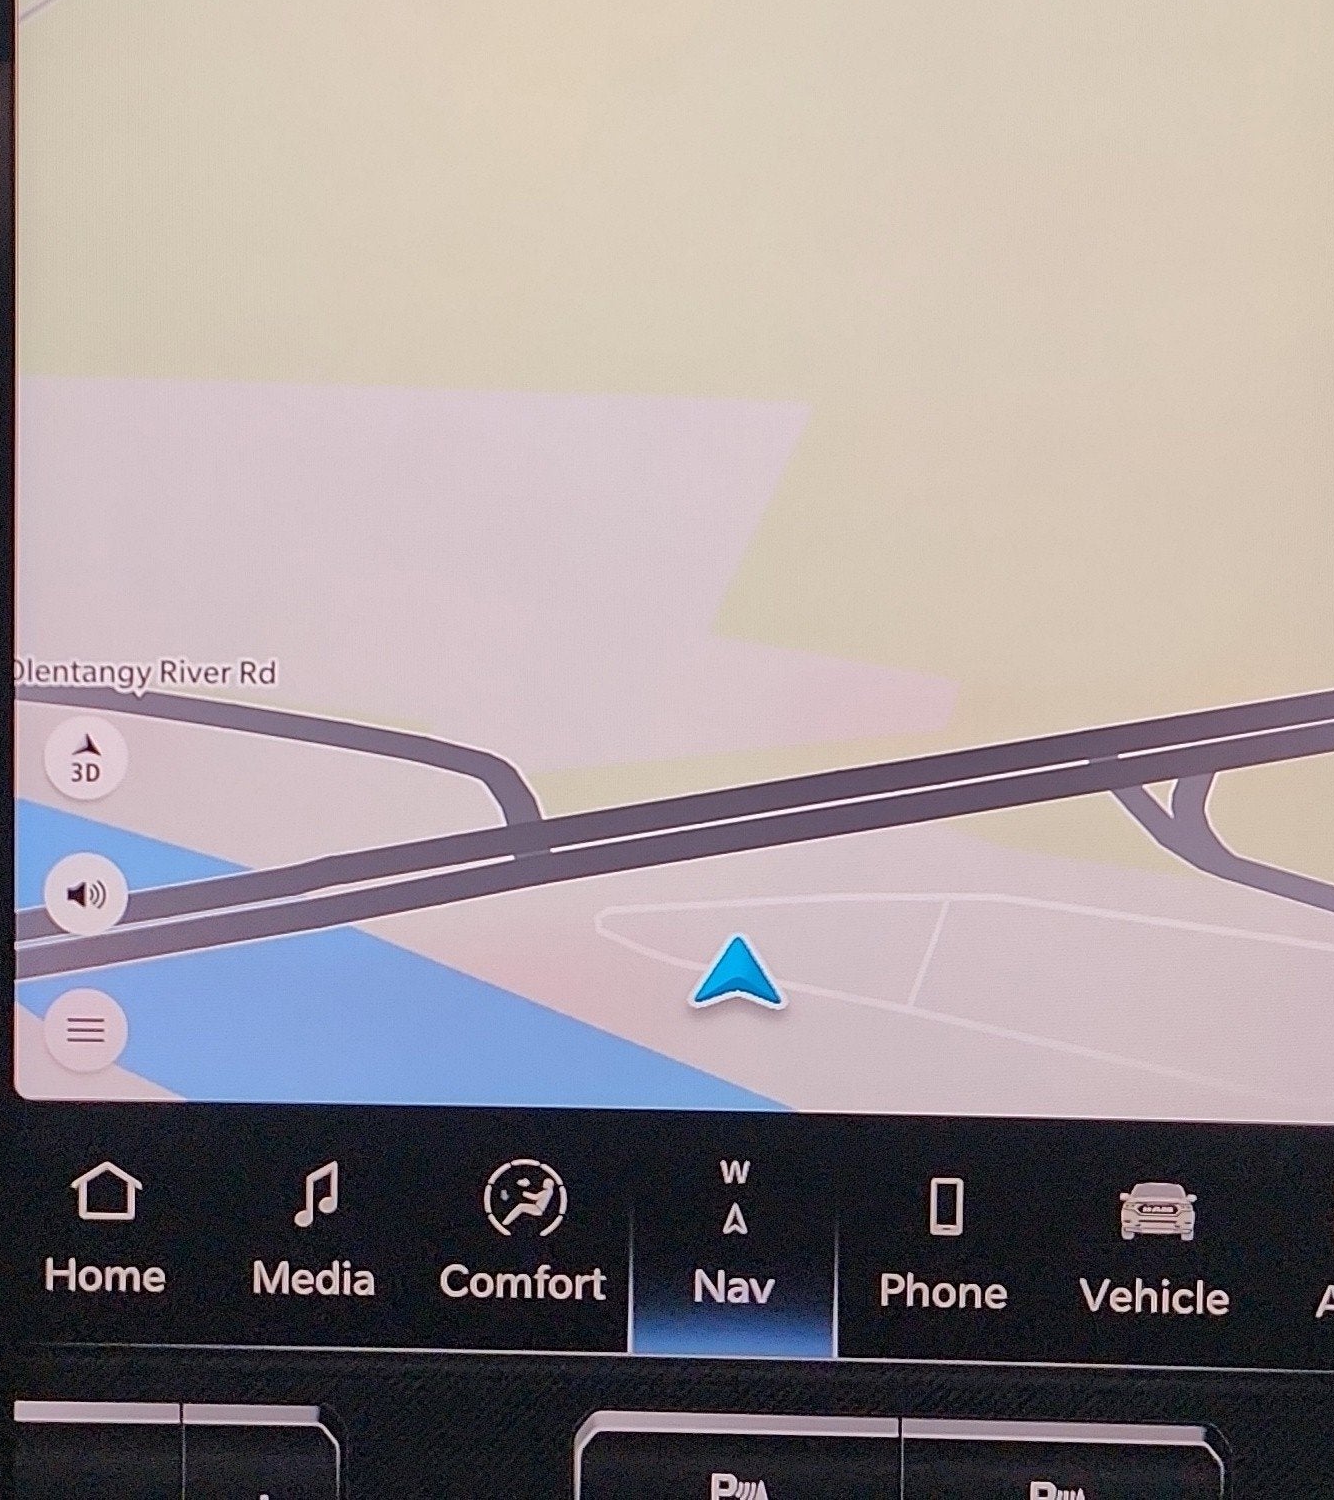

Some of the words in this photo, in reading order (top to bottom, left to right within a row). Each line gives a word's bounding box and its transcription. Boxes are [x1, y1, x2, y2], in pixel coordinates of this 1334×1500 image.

[160, 659, 232, 684] River
[240, 659, 276, 684] Rd
[70, 763, 101, 783] 3D
[720, 1160, 751, 1186] W
[44, 1257, 167, 1294] Home
[253, 1259, 376, 1298] Media
[440, 1263, 607, 1301] Comfort
[694, 1269, 776, 1305] Nav
[880, 1272, 1009, 1310] Phone
[1079, 1276, 1231, 1316] Vehicle
